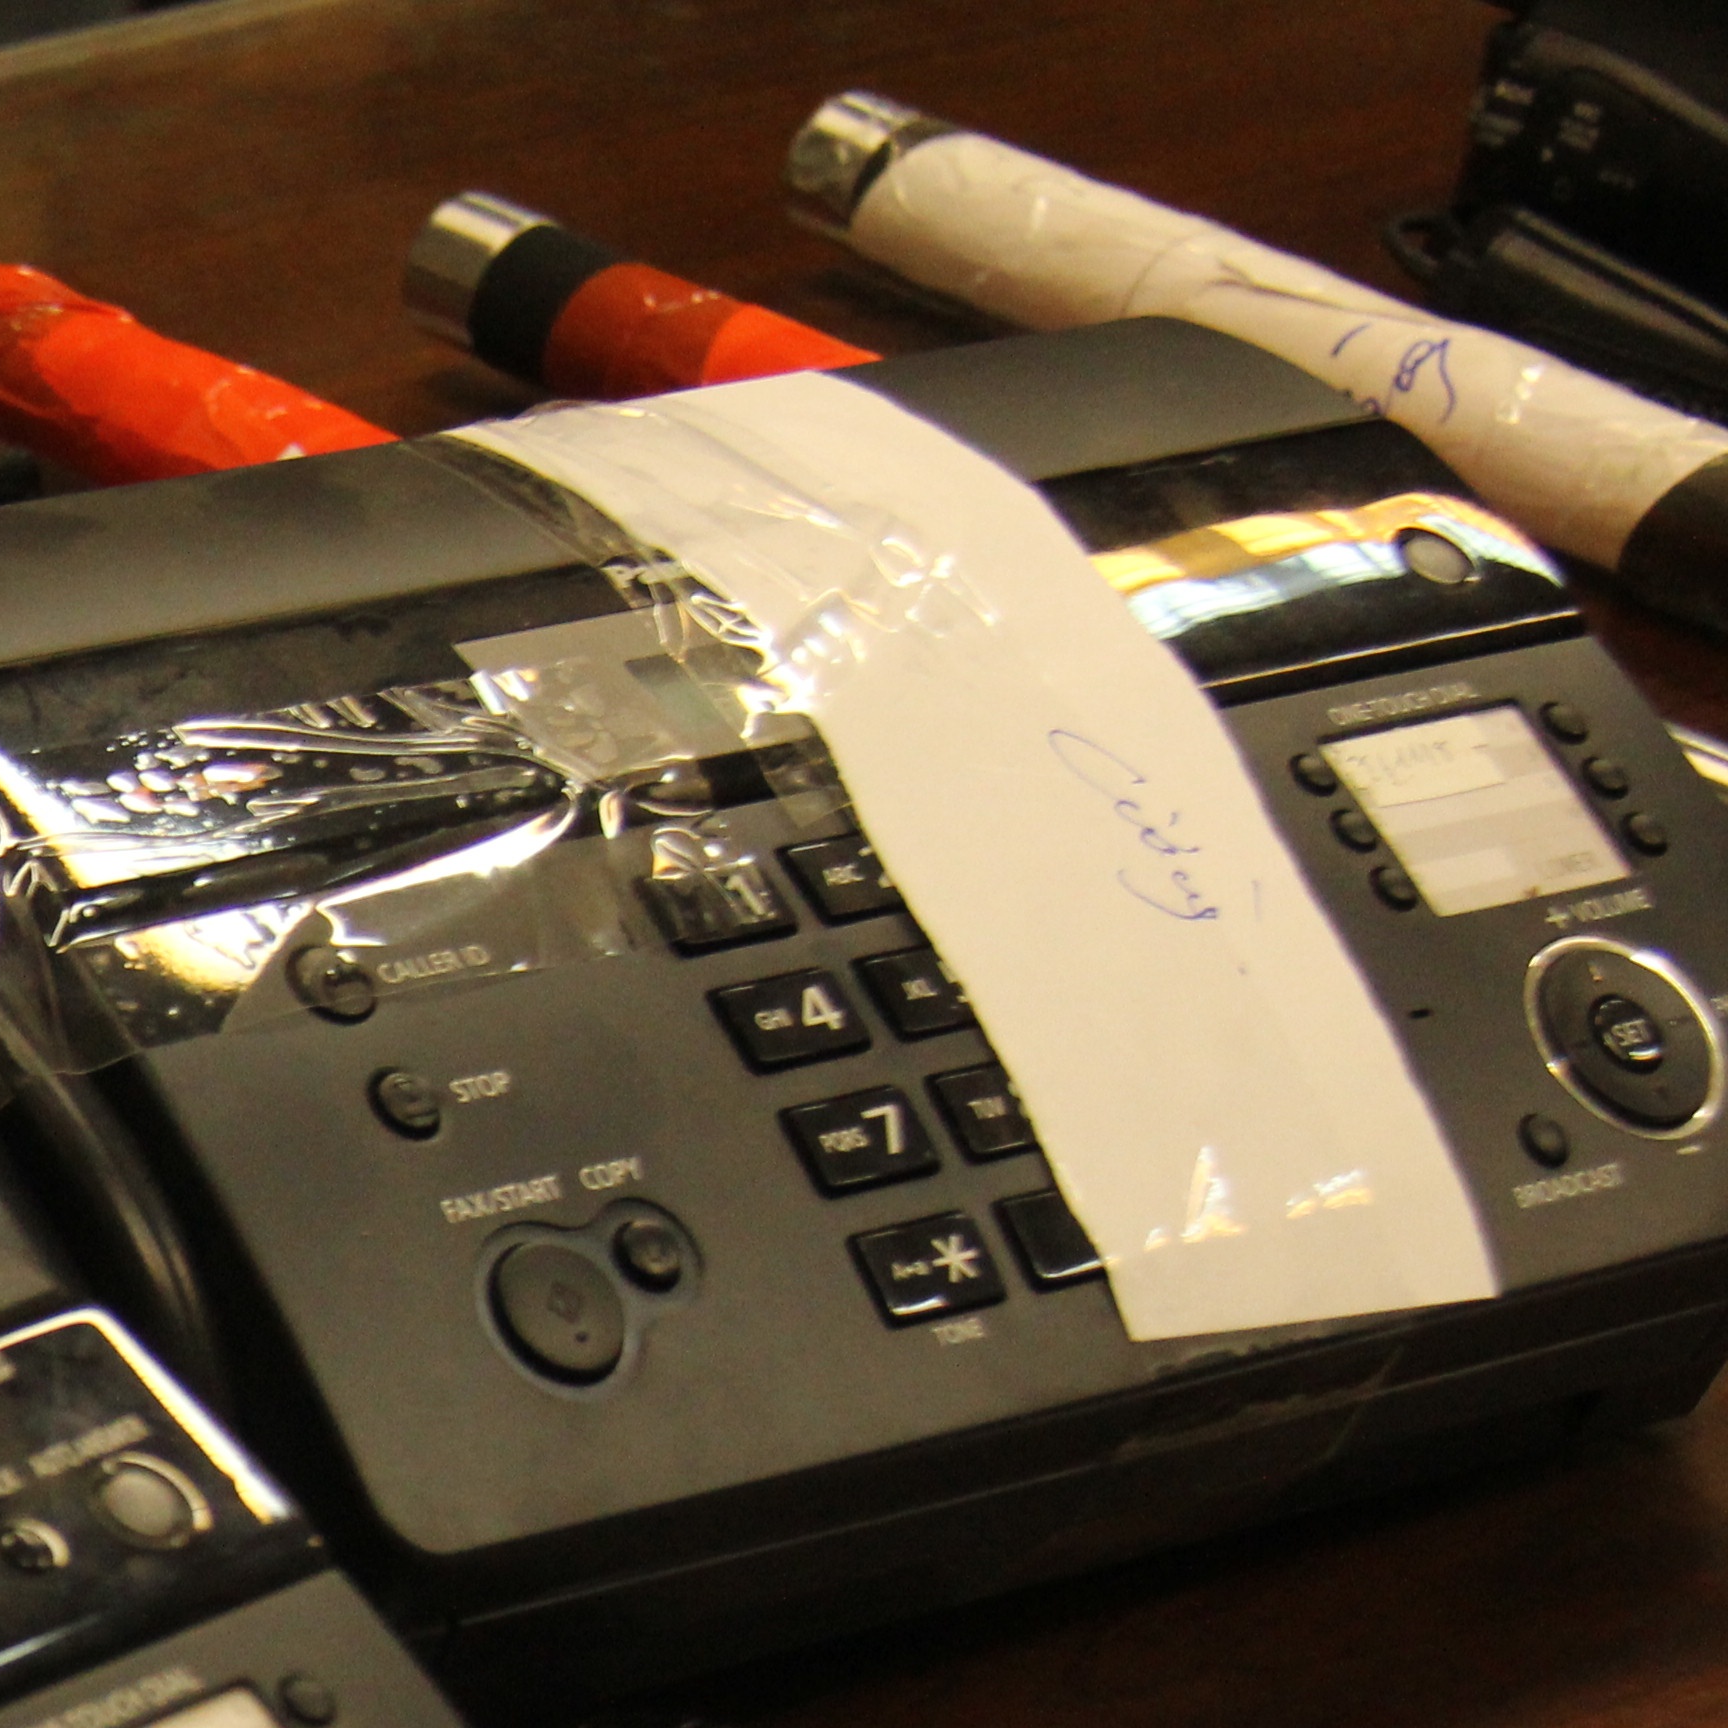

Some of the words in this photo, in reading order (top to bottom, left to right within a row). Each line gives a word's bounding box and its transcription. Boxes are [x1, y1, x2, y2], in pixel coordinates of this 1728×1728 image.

[800, 984, 844, 1031] 4
[448, 1070, 511, 1103] STOP
[860, 1103, 906, 1155] 7
[578, 1156, 642, 1190] COPY
[440, 1173, 564, 1224] FAX/START
